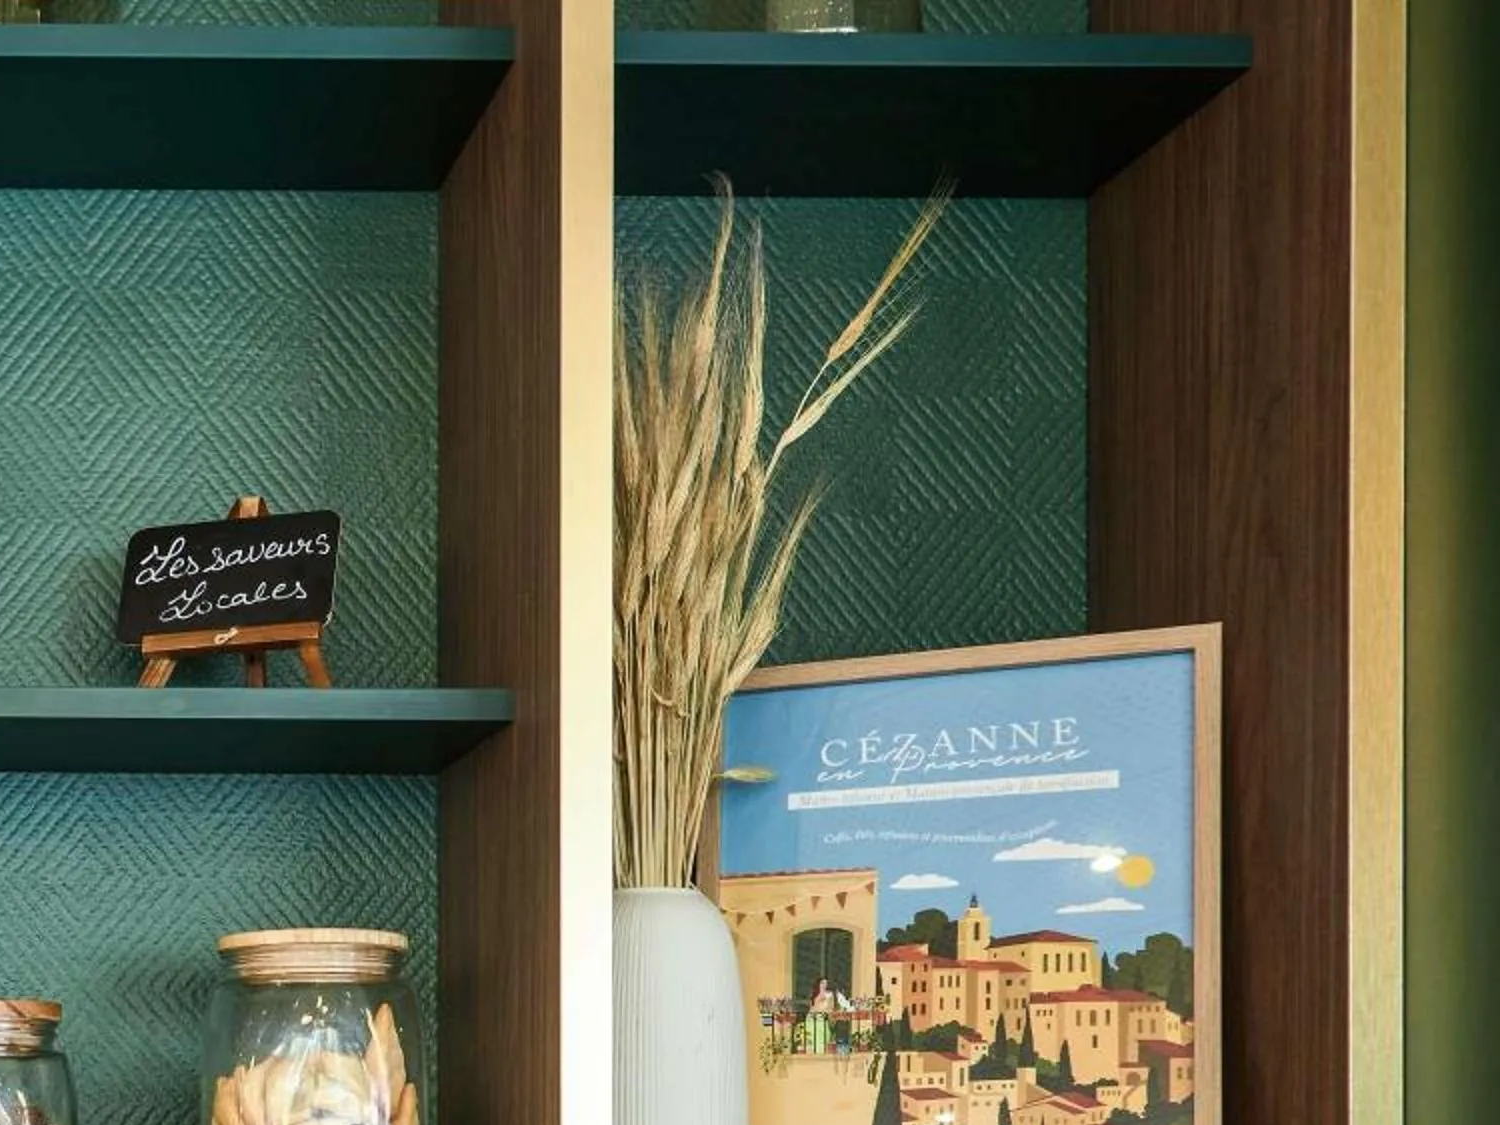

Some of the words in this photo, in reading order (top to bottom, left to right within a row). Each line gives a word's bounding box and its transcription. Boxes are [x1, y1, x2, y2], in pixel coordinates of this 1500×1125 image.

[135, 536, 200, 586] Les
[204, 533, 332, 573] saveurs
[158, 581, 309, 623] Locales
[816, 768, 866, 783] en
[883, 744, 1091, 785] Provence
[820, 717, 1080, 768] CÉZANNE
